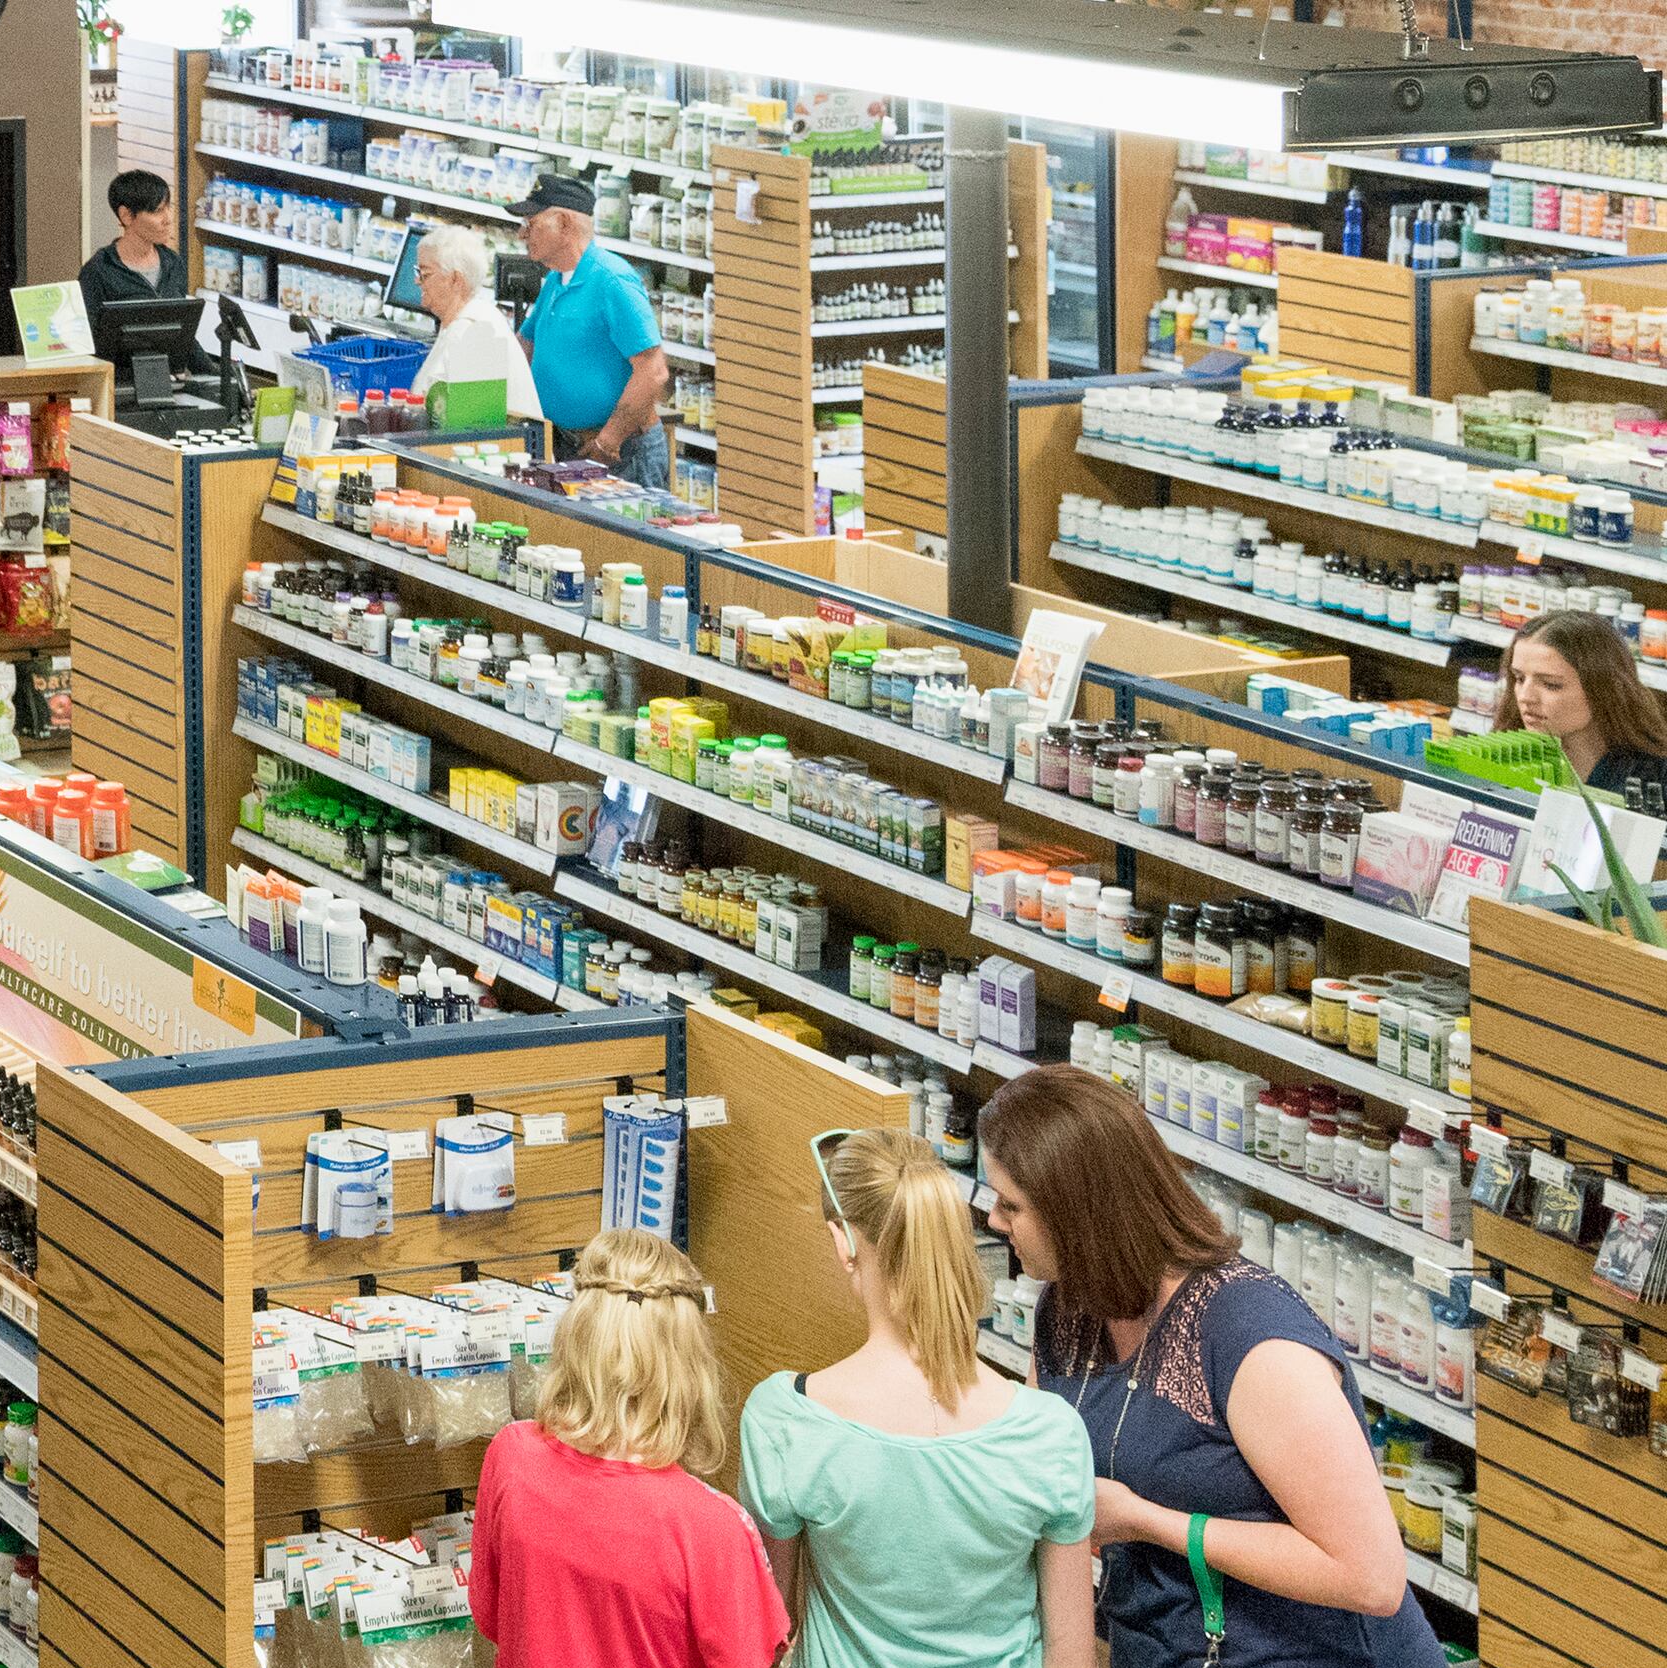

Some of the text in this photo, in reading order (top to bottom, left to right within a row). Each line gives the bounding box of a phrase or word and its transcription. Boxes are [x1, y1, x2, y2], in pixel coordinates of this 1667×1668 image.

[1456, 817, 1514, 858] REDEFINING
[1446, 850, 1474, 875] AGE
[68, 955, 92, 996] to
[96, 965, 169, 1039] better
[308, 1345, 320, 1355] Size
[454, 1342, 478, 1354] Size 00
[300, 1349, 356, 1367] Vegetarian Capsules
[432, 1349, 501, 1366] Empty Gelatin Capsules
[260, 1383, 290, 1395] Capsules
[402, 1595, 414, 1607] Size
[364, 1600, 468, 1628] Empty Vegetarian Capsules
